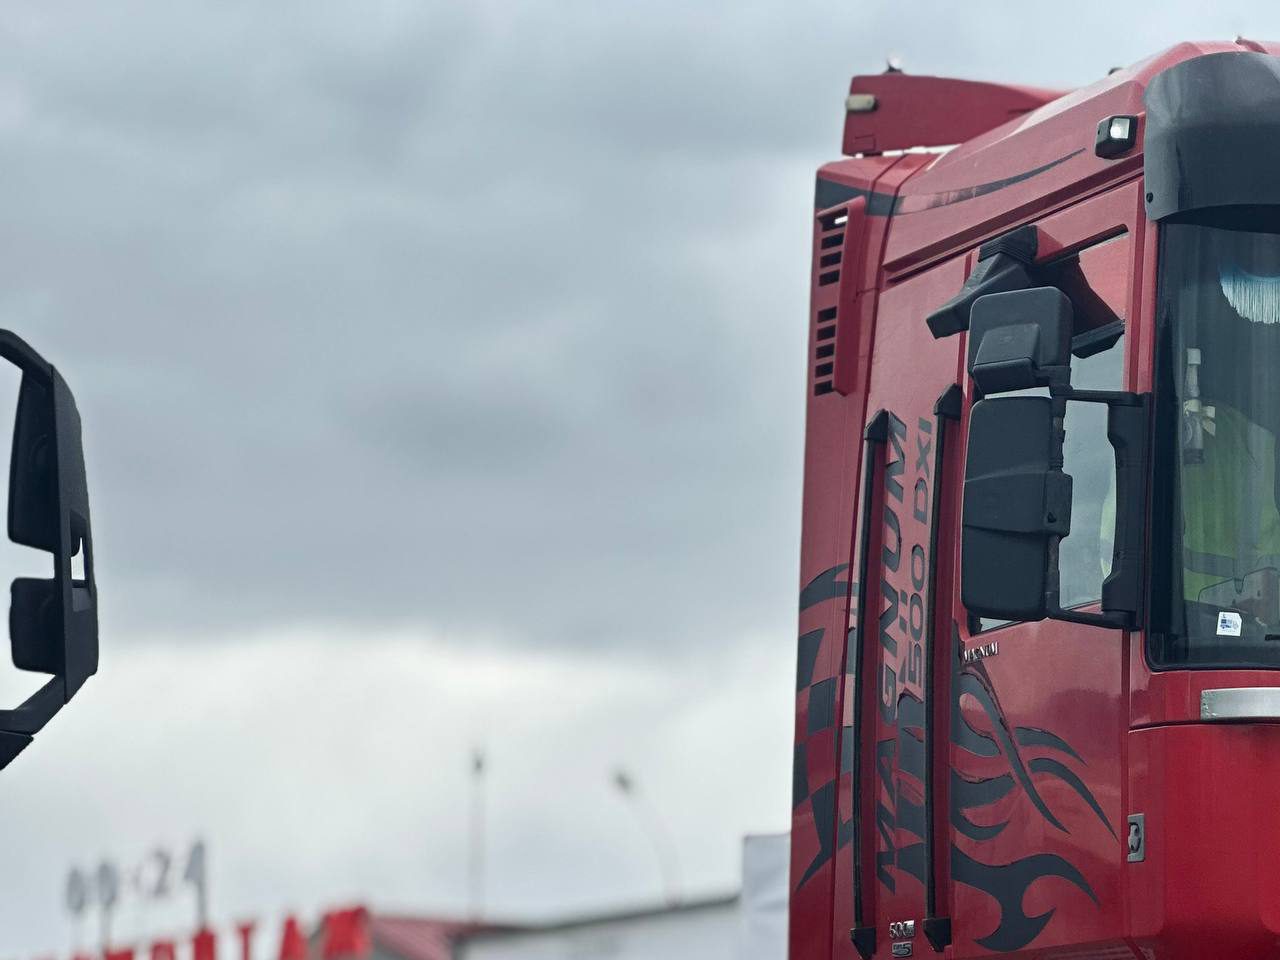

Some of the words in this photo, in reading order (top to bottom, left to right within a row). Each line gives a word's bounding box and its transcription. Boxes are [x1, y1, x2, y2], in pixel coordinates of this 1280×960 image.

[913, 416, 933, 525] DXI
[876, 410, 906, 895] MAGNUM
[907, 543, 926, 690] 500
